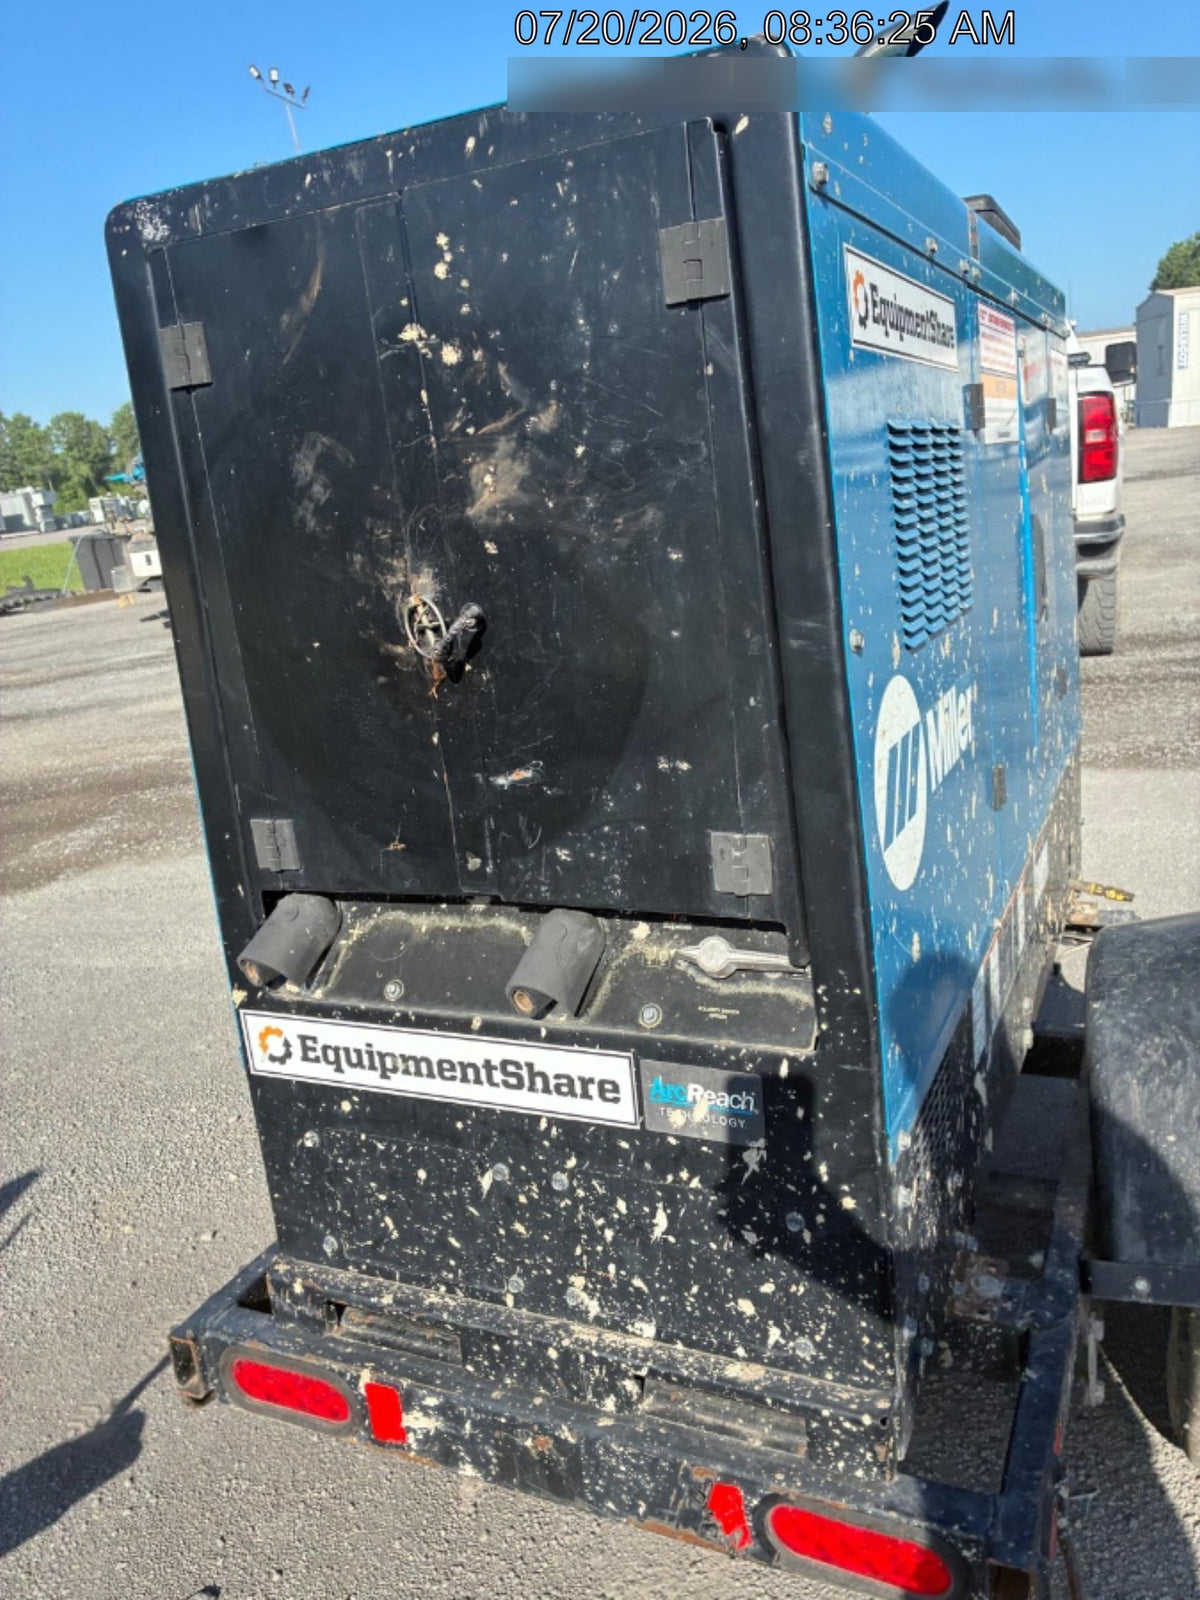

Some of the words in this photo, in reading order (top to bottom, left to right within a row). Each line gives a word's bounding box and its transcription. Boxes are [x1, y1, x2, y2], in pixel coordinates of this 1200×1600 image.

[869, 282, 955, 349] EquipmentShare
[926, 685, 975, 792] Miller
[299, 1034, 623, 1104] EquipmentShare
[649, 1075, 755, 1113] ArcReach
[658, 1107, 747, 1129] TEHOLOGY
